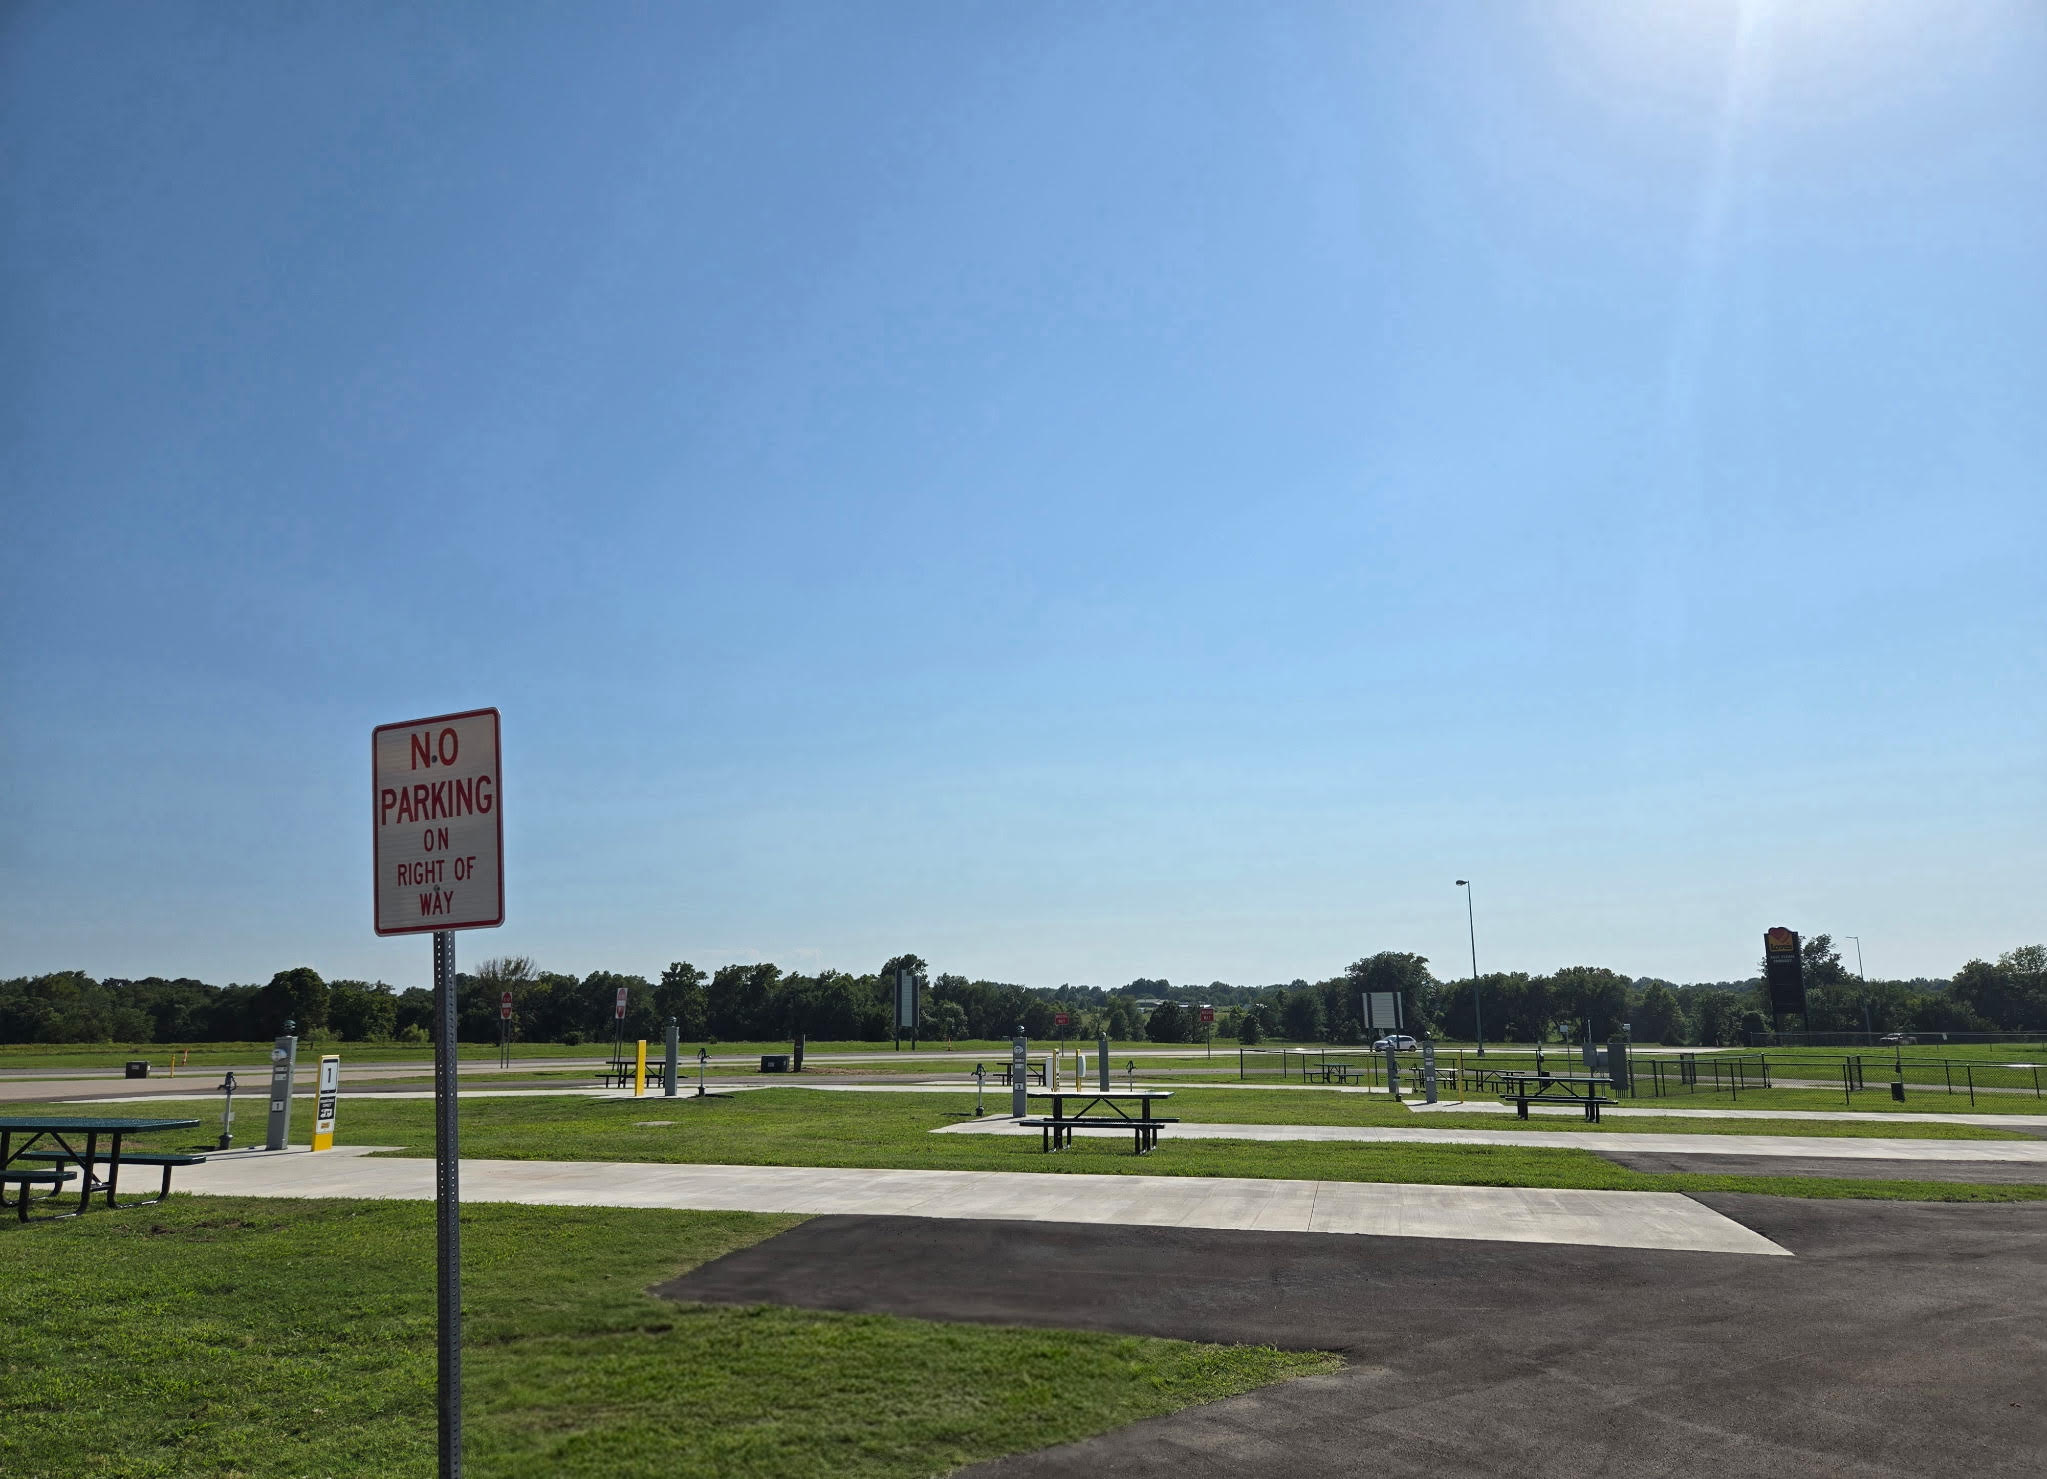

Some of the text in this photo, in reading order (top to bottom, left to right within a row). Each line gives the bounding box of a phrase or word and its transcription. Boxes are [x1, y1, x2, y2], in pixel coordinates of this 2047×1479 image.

[411, 727, 459, 770] NO
[381, 775, 492, 825] PARKING
[423, 827, 449, 852] ON
[397, 856, 476, 886] RIGHT OF
[419, 891, 454, 916] WAY
[328, 1068, 332, 1083] 1
